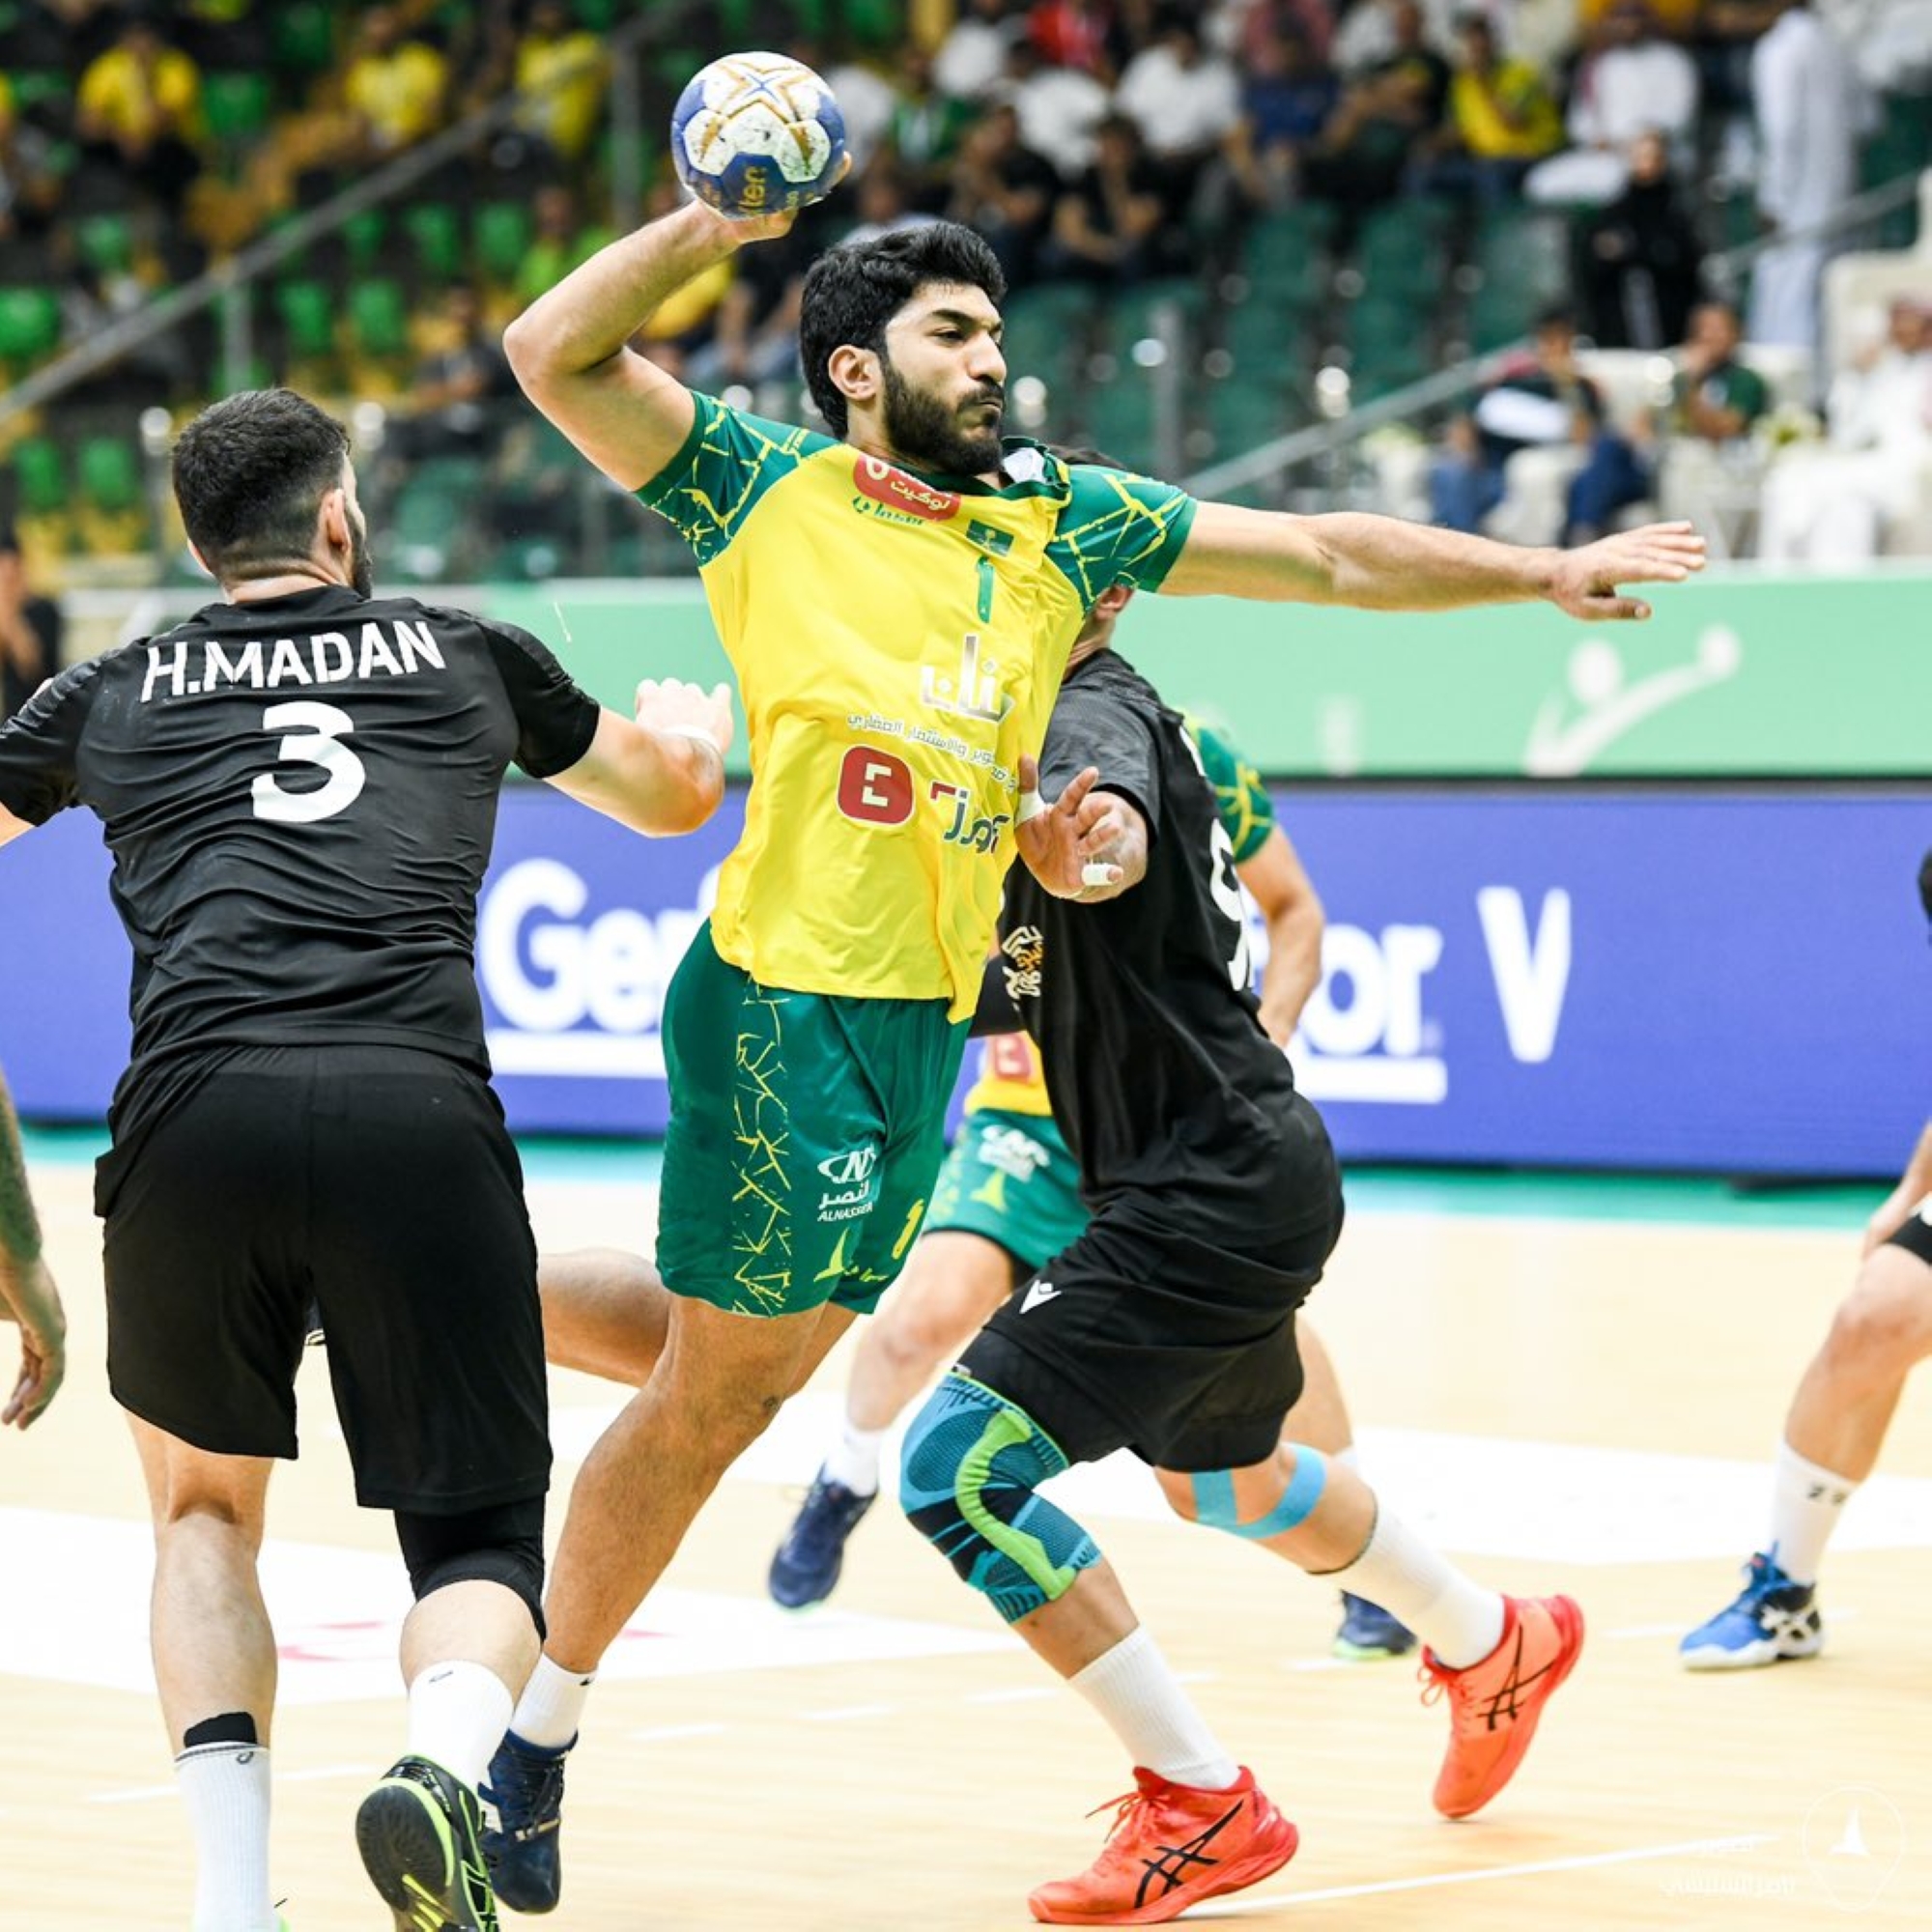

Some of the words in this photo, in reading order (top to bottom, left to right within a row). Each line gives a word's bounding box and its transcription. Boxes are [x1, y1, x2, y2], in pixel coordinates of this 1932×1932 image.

[976, 555, 996, 624] 1
[140, 620, 447, 703] H.MADAN
[250, 700, 366, 823] 3
[1477, 885, 1572, 1064] V
[891, 1198, 924, 1260] 1
